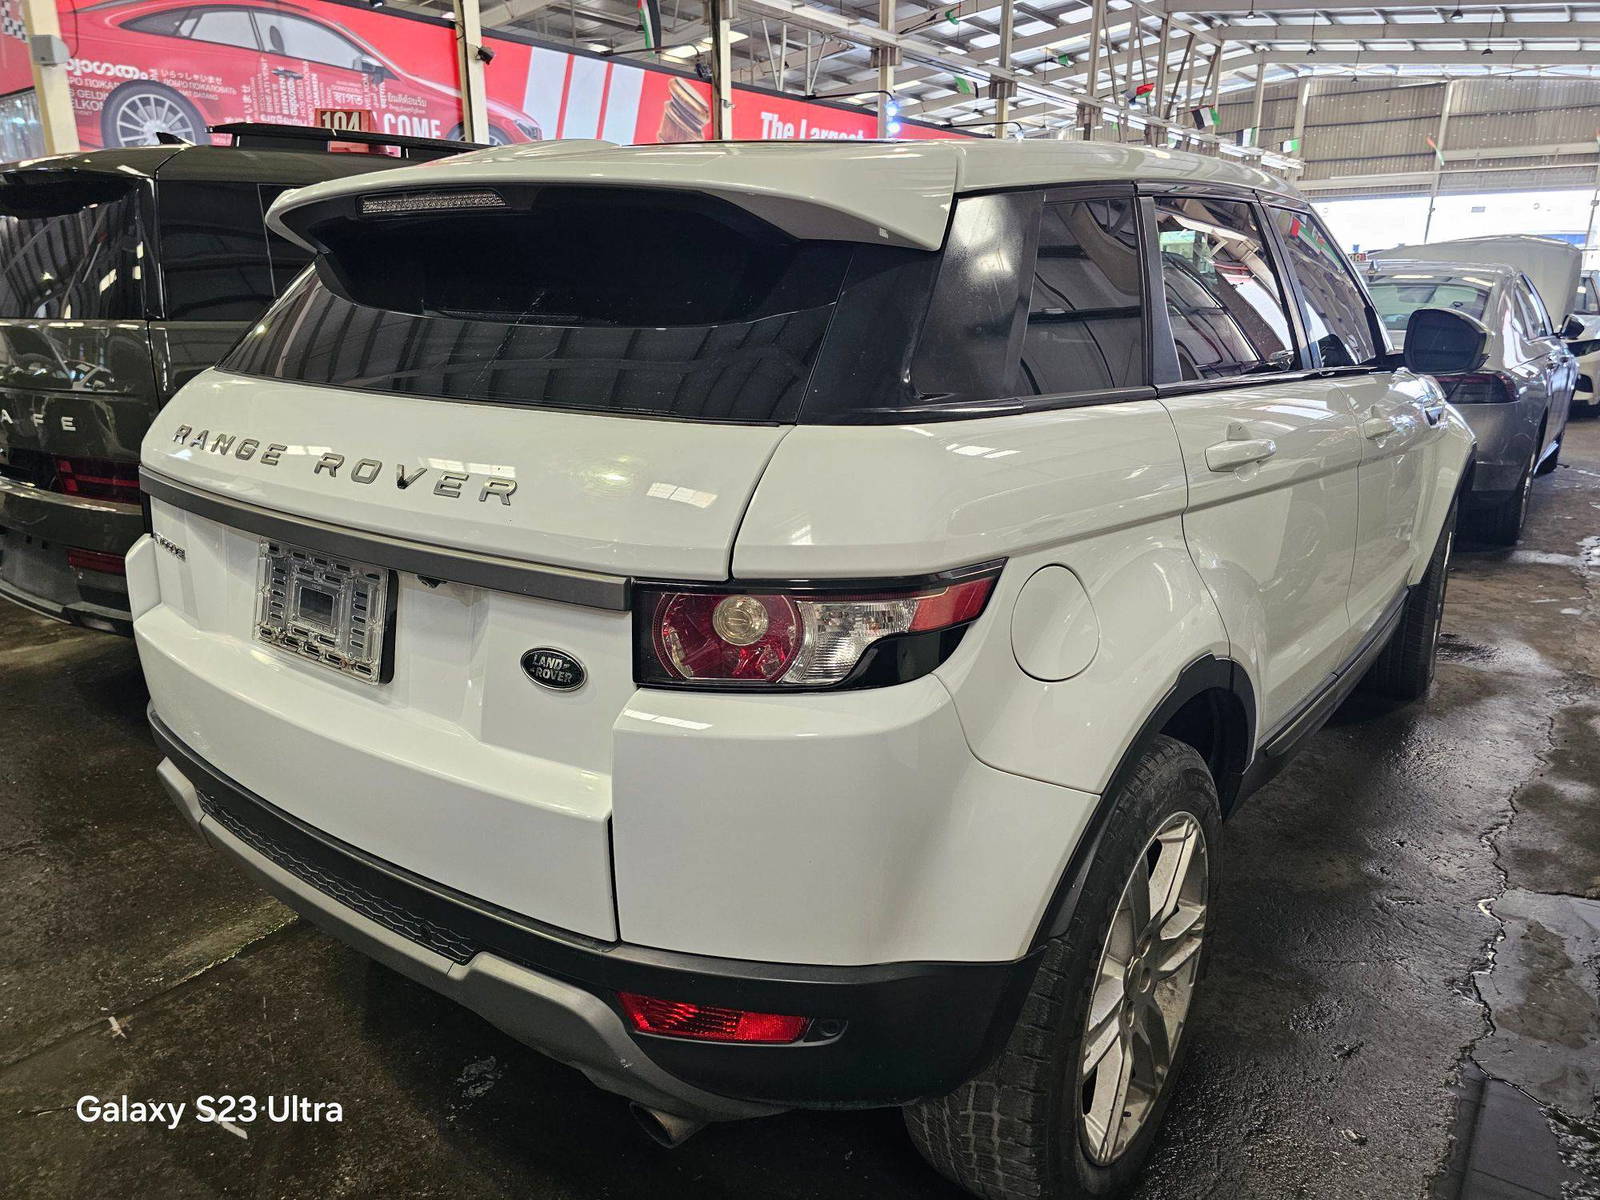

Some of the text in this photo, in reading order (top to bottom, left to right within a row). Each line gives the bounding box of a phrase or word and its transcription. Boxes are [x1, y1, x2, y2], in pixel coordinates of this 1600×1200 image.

[761, 111, 795, 140] The
[172, 423, 518, 506] RANGE ROVER
[532, 653, 564, 671] LAND
[535, 666, 574, 683] ROVER
